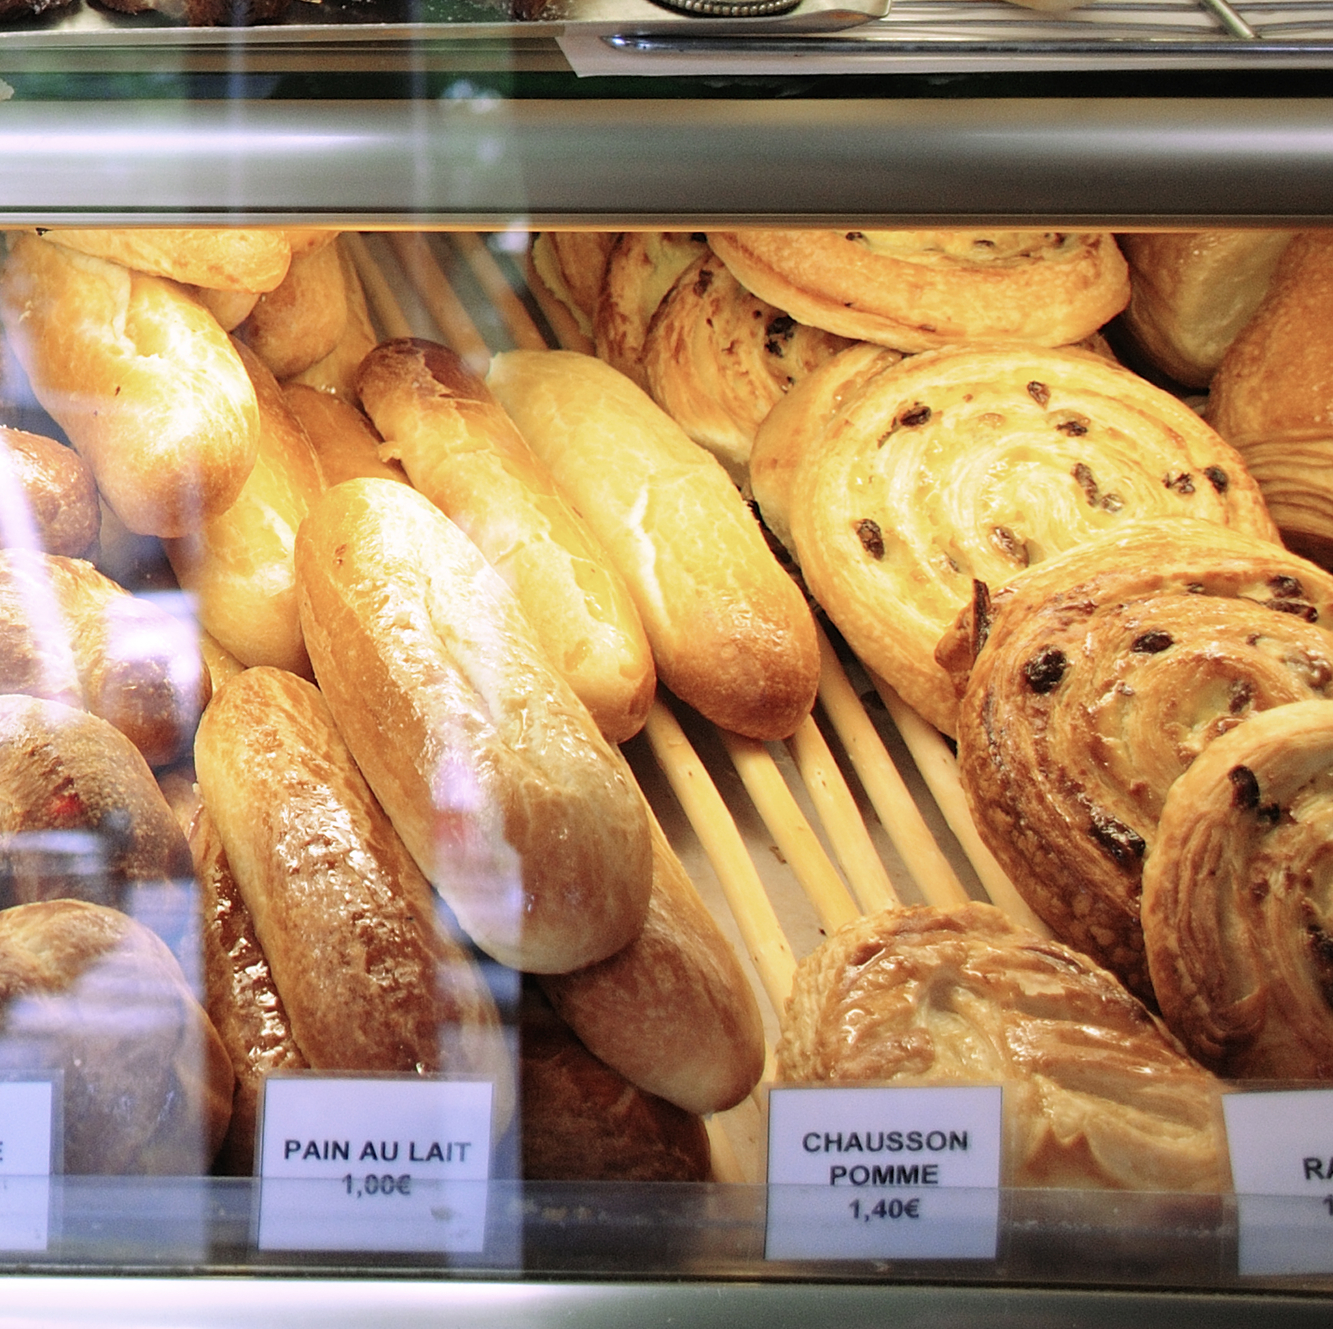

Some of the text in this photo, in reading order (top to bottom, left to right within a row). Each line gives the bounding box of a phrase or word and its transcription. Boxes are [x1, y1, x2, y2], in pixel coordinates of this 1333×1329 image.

[284, 1139, 471, 1162] PAIN AU LAIT
[802, 1130, 968, 1153] CHAUSSON
[342, 1174, 412, 1199] 1,00€
[830, 1164, 939, 1186] POMME
[848, 1197, 920, 1222] 1,40€
